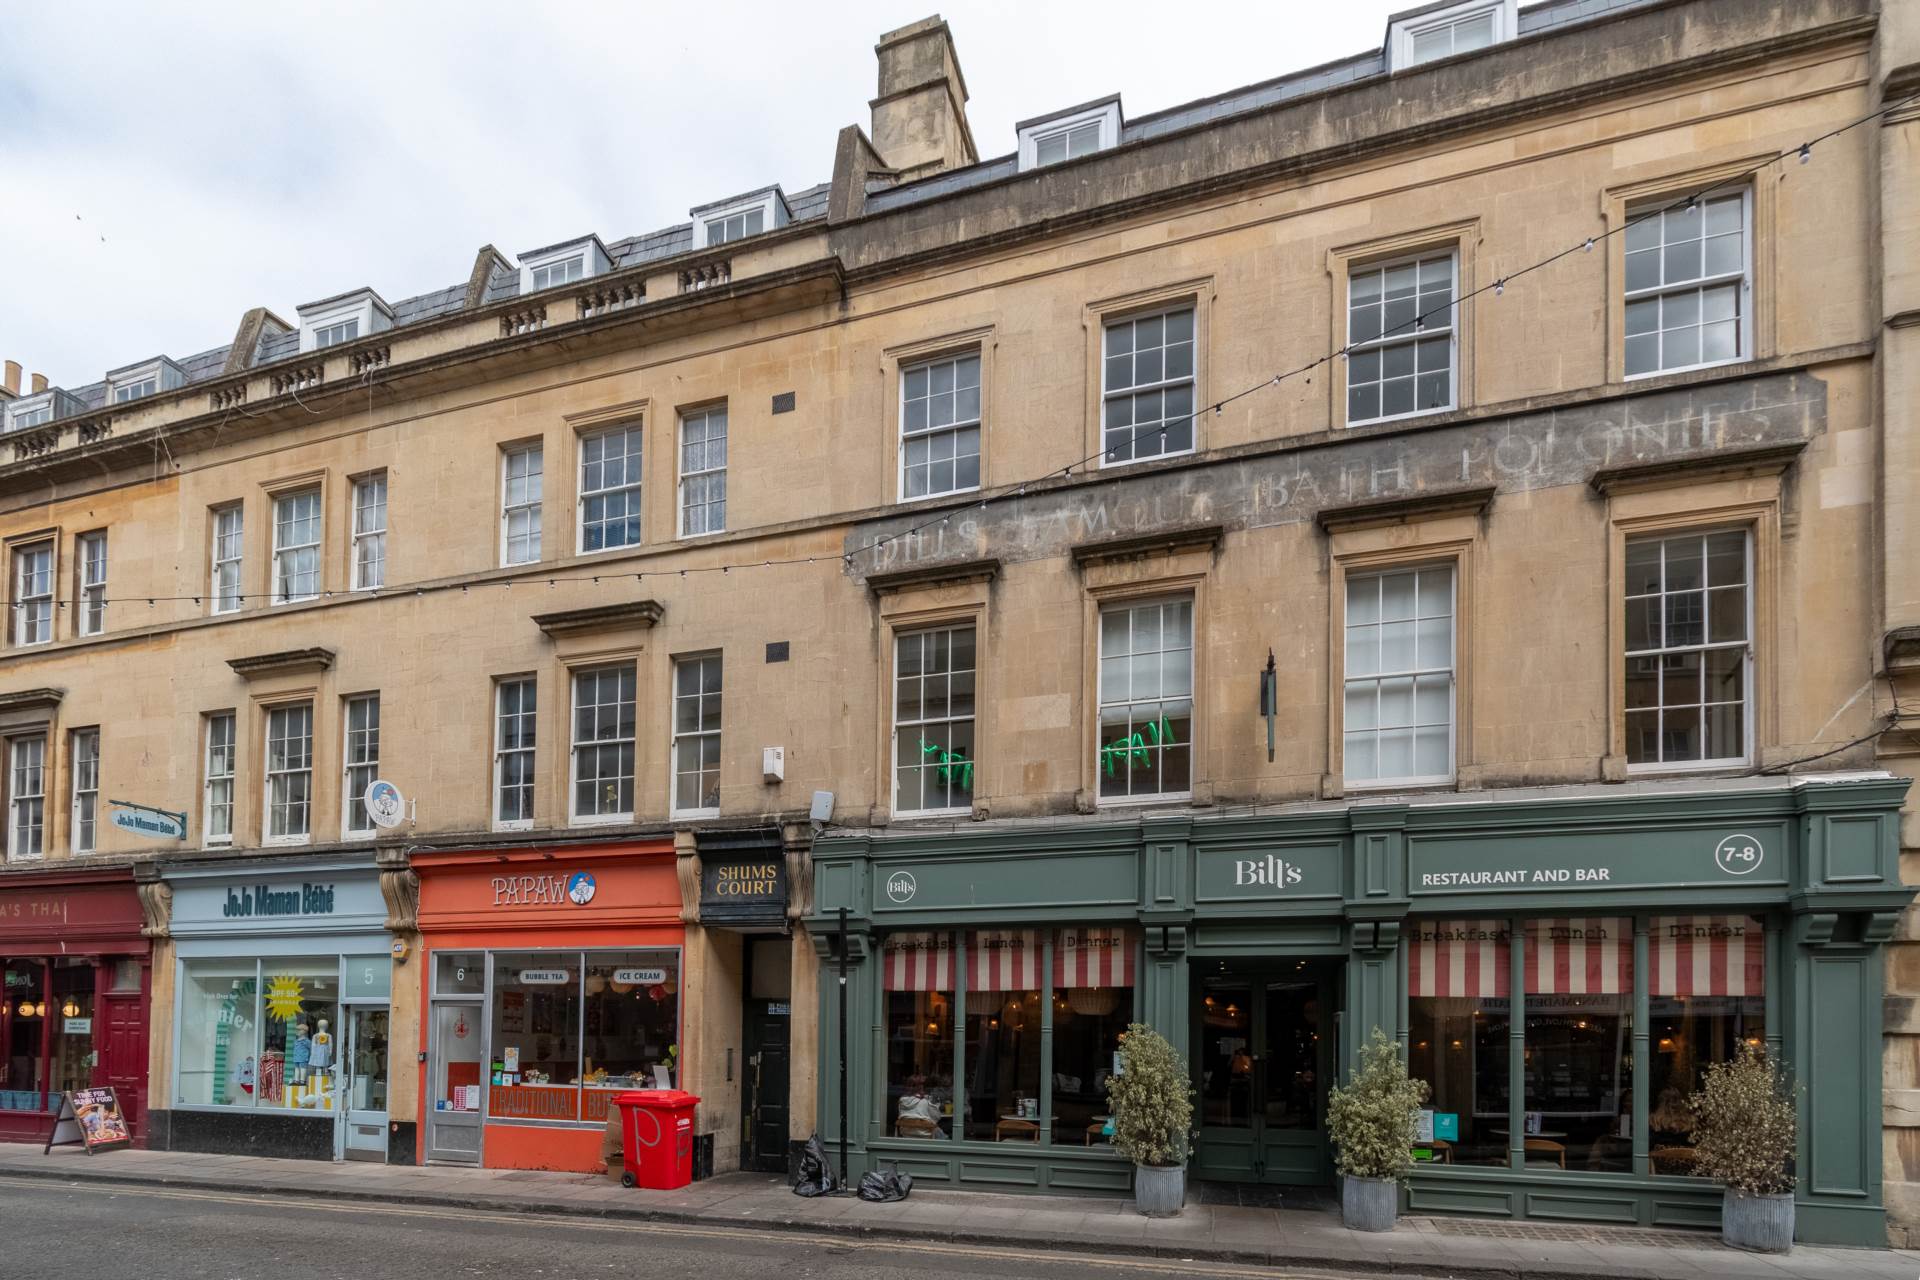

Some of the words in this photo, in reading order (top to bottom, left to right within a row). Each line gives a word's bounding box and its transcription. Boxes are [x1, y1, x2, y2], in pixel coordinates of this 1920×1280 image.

[117, 814, 133, 827] JoJo
[134, 817, 158, 831] Maman
[1723, 846, 1756, 862] 7-8
[718, 864, 777, 880] SHUMS
[1234, 854, 1302, 889] Bill's
[1422, 869, 1528, 886] RESTAURANT
[1532, 868, 1571, 883] AND
[1575, 867, 1611, 882] BAR
[491, 874, 569, 905] PAPAW
[716, 880, 777, 896] COURT
[888, 879, 915, 895] Bill's
[223, 886, 253, 917] JoJo
[254, 884, 301, 917] Maman
[302, 882, 335, 915] Bébé
[1411, 926, 1510, 943] Breakfast
[1548, 926, 1608, 941] Lunch
[1668, 923, 1746, 939] Dinner
[983, 936, 1025, 949] Lunch
[1066, 934, 1121, 948] Dinner
[364, 967, 374, 985] 5
[456, 968, 465, 981] 6
[525, 973, 549, 981] BUBBLE
[551, 973, 564, 981] TEA
[619, 972, 631, 980] ICE
[634, 972, 661, 980] CREAM
[492, 1088, 575, 1117] TRADITIONAL
